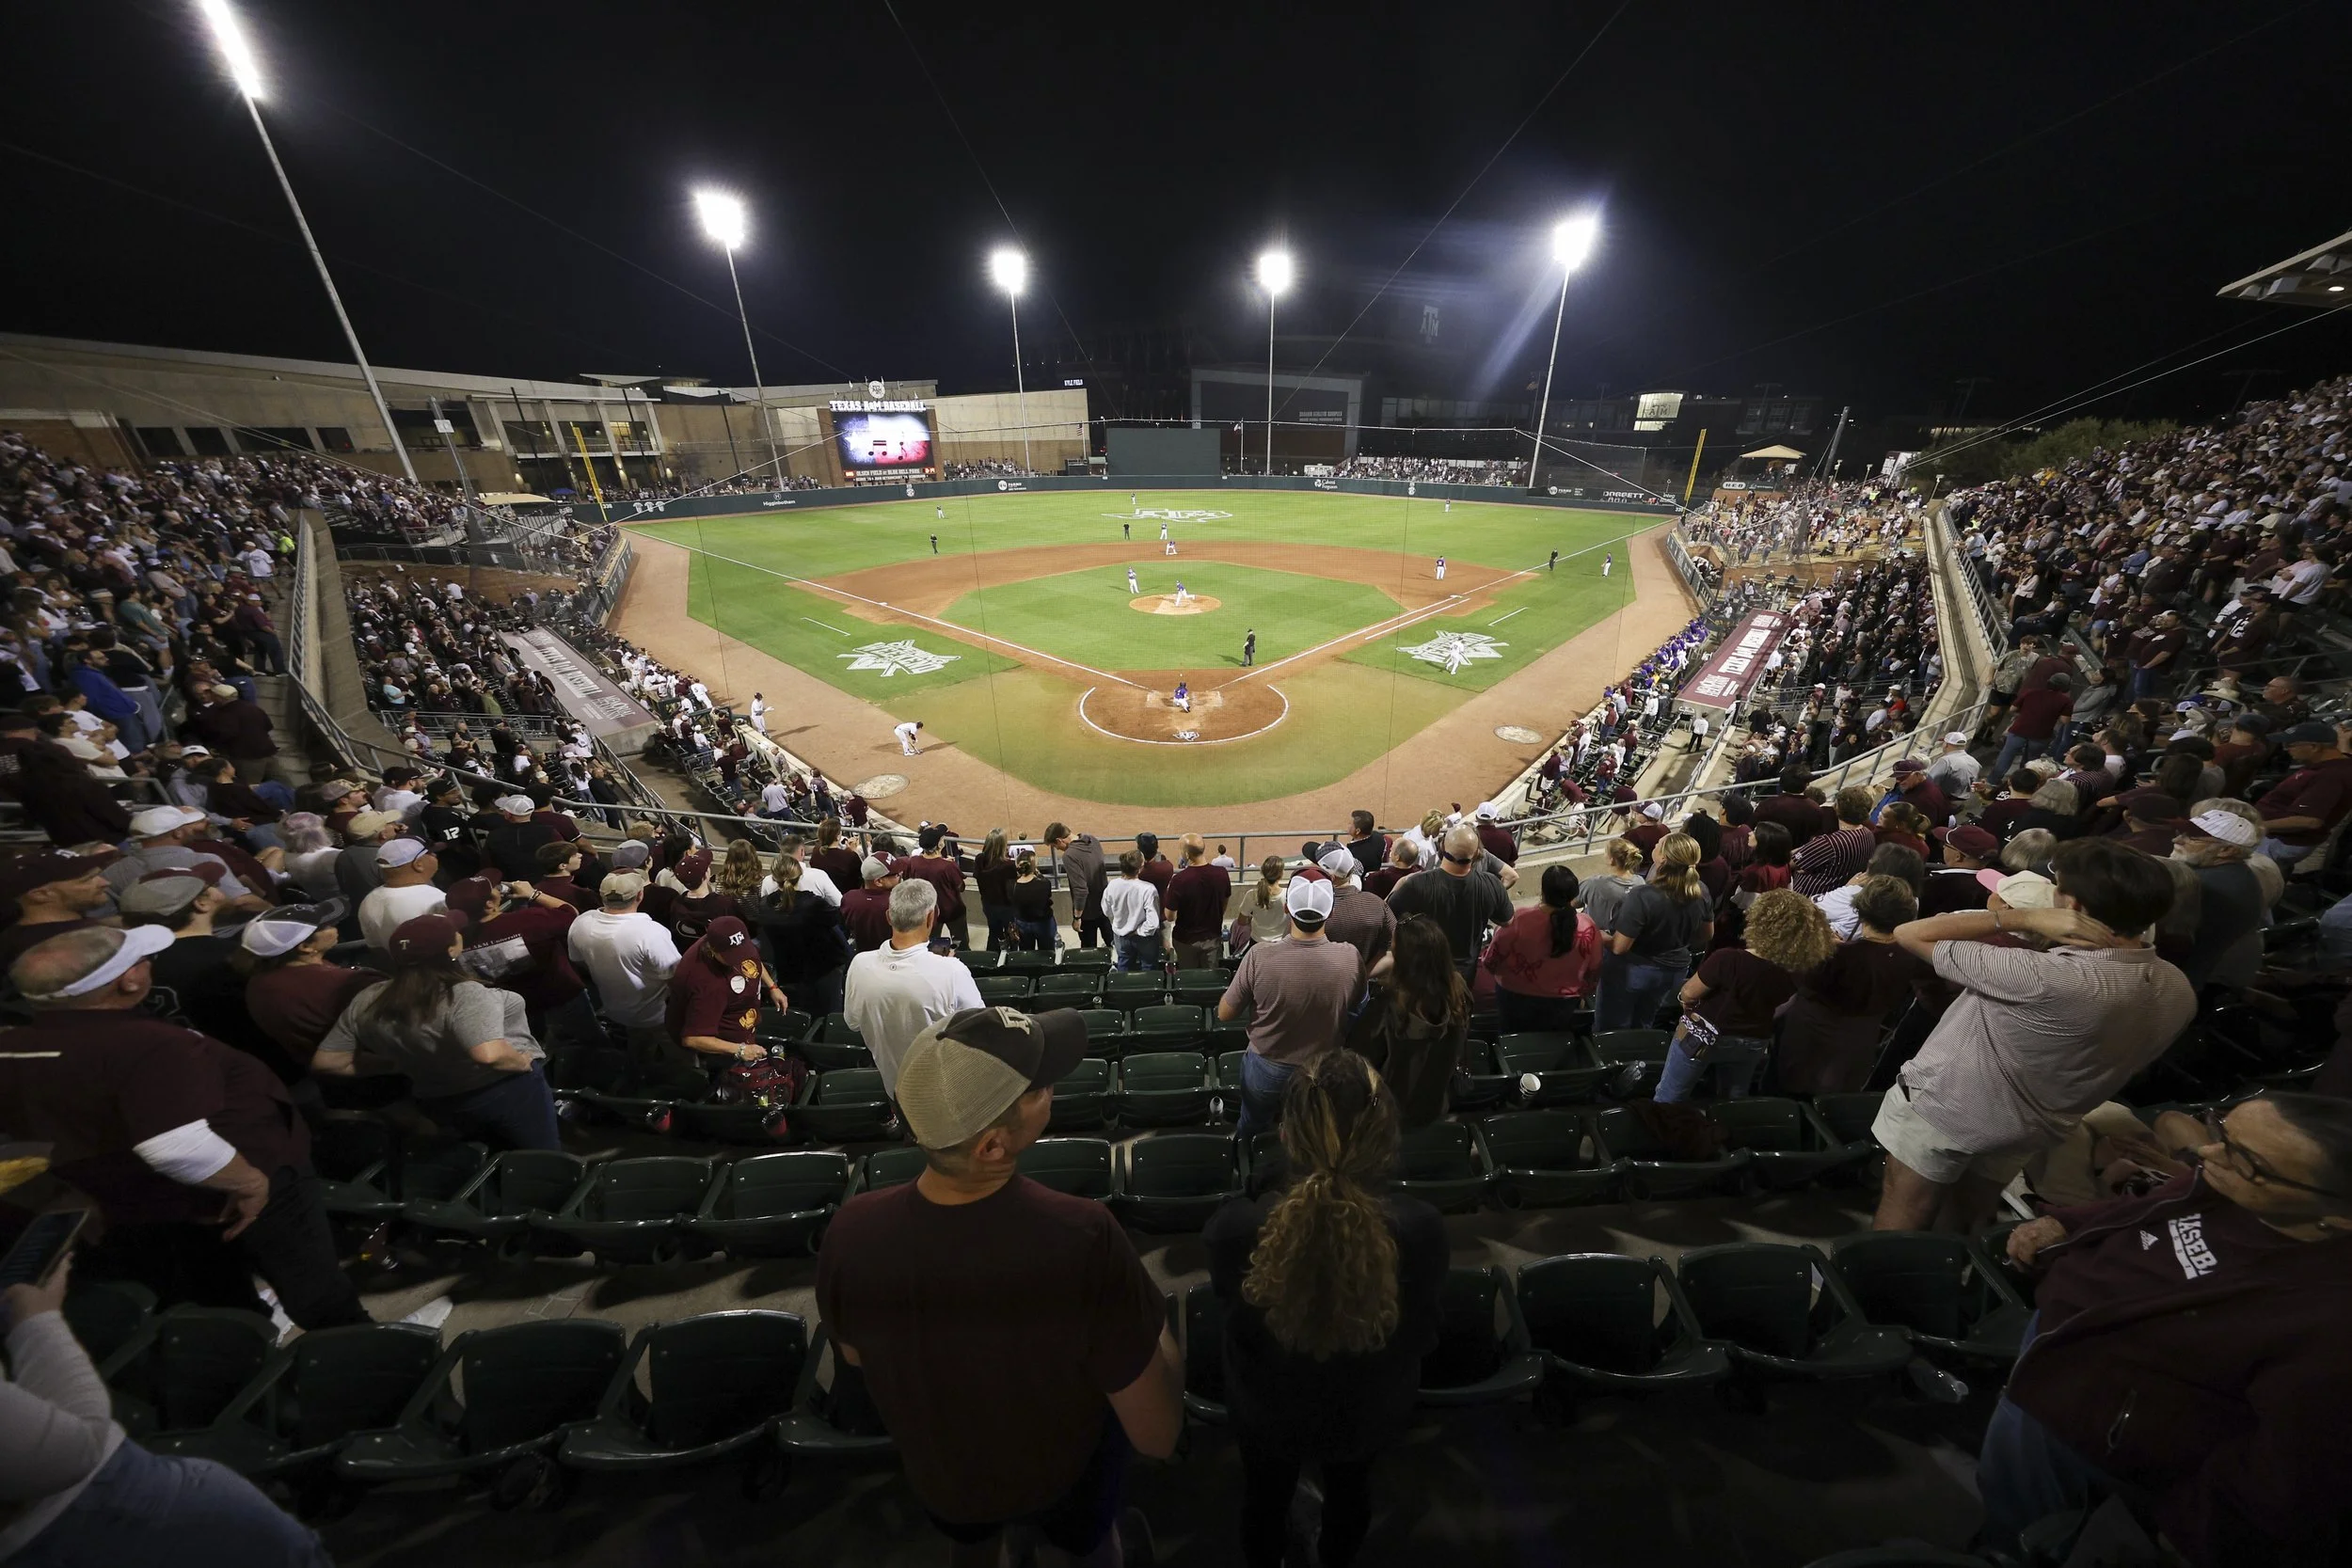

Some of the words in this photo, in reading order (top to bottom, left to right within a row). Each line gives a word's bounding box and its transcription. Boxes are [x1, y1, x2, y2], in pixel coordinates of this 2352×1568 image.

[829, 401, 862, 412] TEXAS
[883, 400, 927, 412] BASEBALL
[443, 827, 460, 840] 12
[491, 933, 521, 945] University
